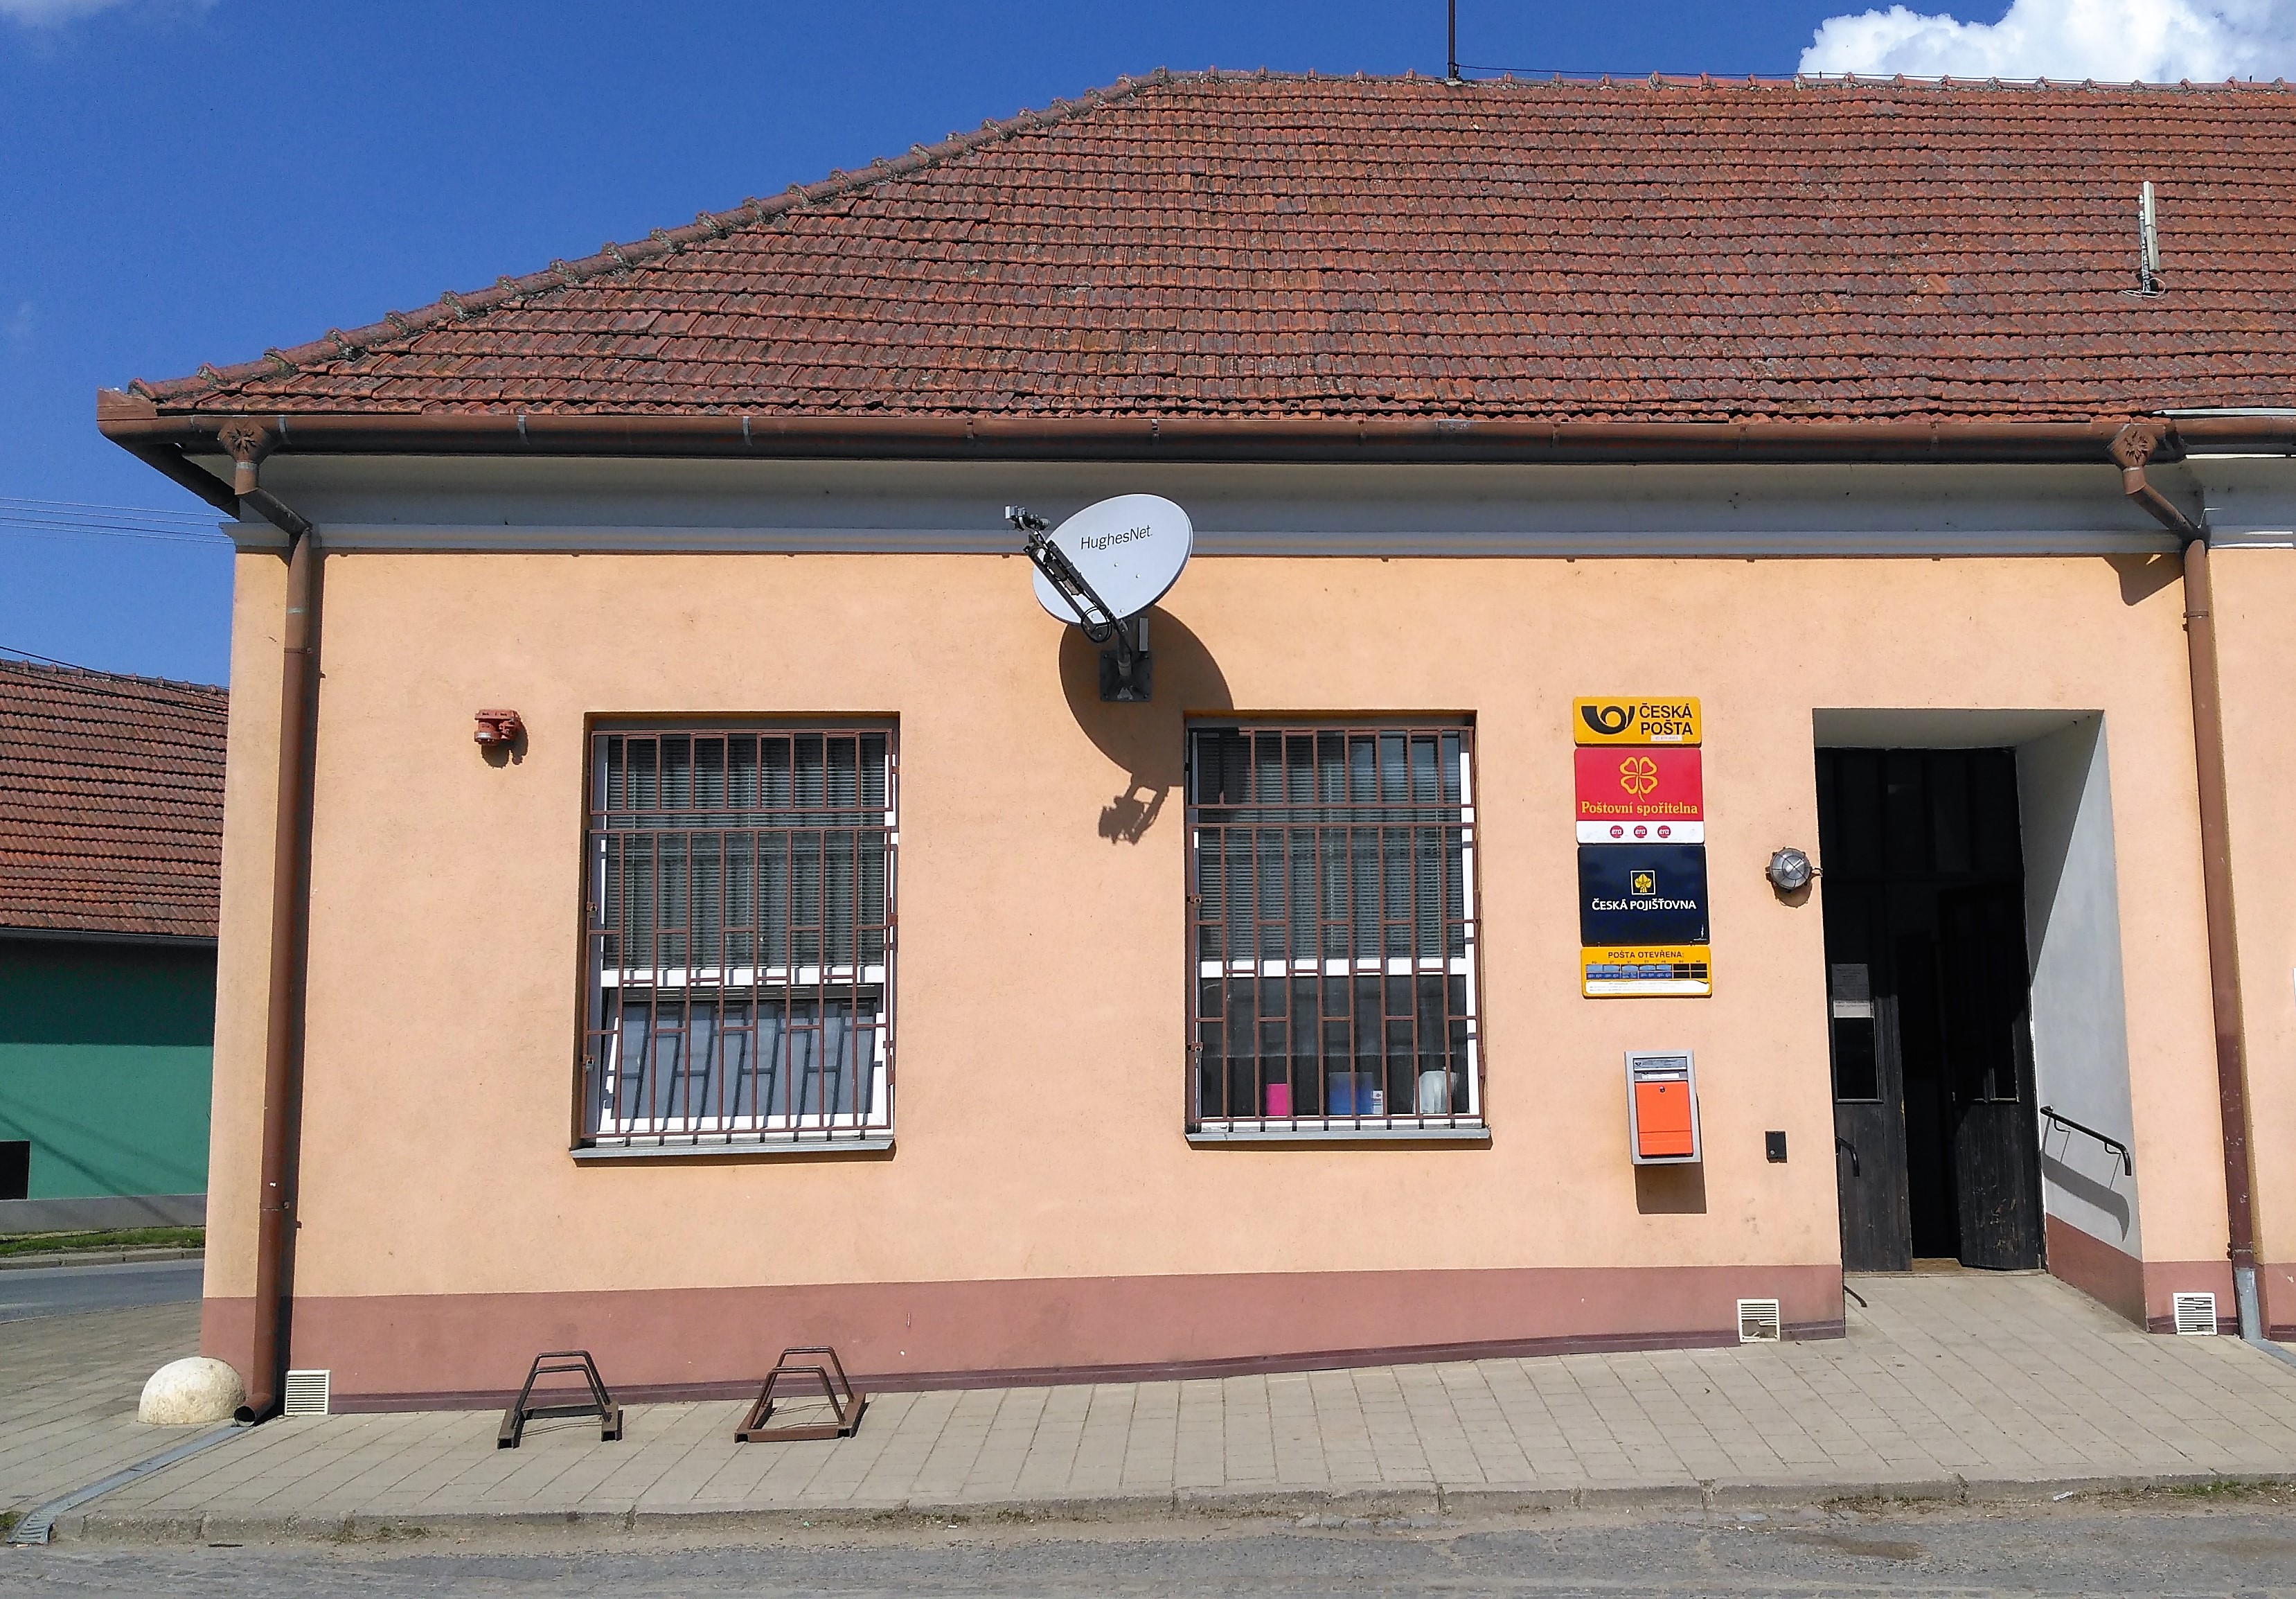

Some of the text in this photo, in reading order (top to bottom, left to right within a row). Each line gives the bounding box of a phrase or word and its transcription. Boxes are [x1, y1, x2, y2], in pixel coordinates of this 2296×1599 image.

[1081, 525, 1151, 550] HughesNet
[1639, 703, 1693, 718] ČESKÁ
[1640, 719, 1693, 735] POŠTA
[1581, 801, 1698, 816] Poštovní spořitelna
[1592, 898, 1697, 911] ČESKÁ POJIŠŤOVNA
[1608, 950, 1635, 958] POŠTA
